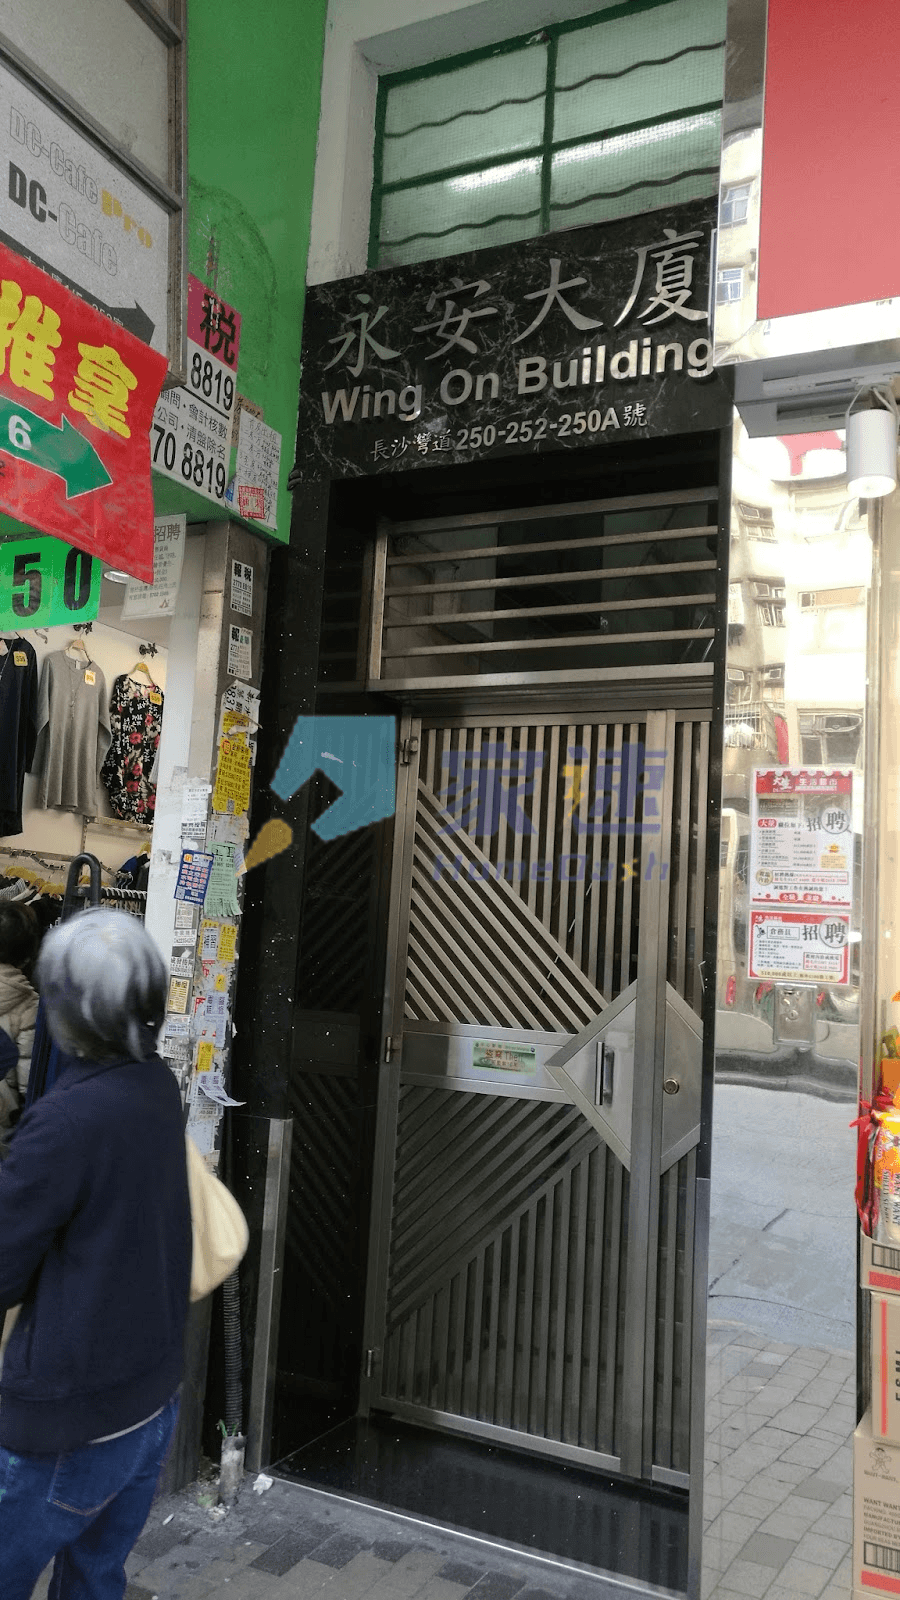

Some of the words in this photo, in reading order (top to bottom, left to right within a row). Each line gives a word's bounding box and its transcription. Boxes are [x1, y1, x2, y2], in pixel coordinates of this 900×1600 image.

[10, 105, 98, 204] DC-Cafe
[8, 160, 118, 276] DC-Cafe
[322, 228, 710, 378] 永安大廈
[190, 351, 234, 411] 8819
[320, 384, 423, 425] Wing
[438, 367, 499, 406] On
[516, 336, 714, 396] Building
[8, 414, 32, 450] 6
[181, 442, 226, 499] 8819
[154, 522, 181, 543] 招聘
[807, 811, 846, 832] 招聘
[802, 922, 846, 944] 招聘
